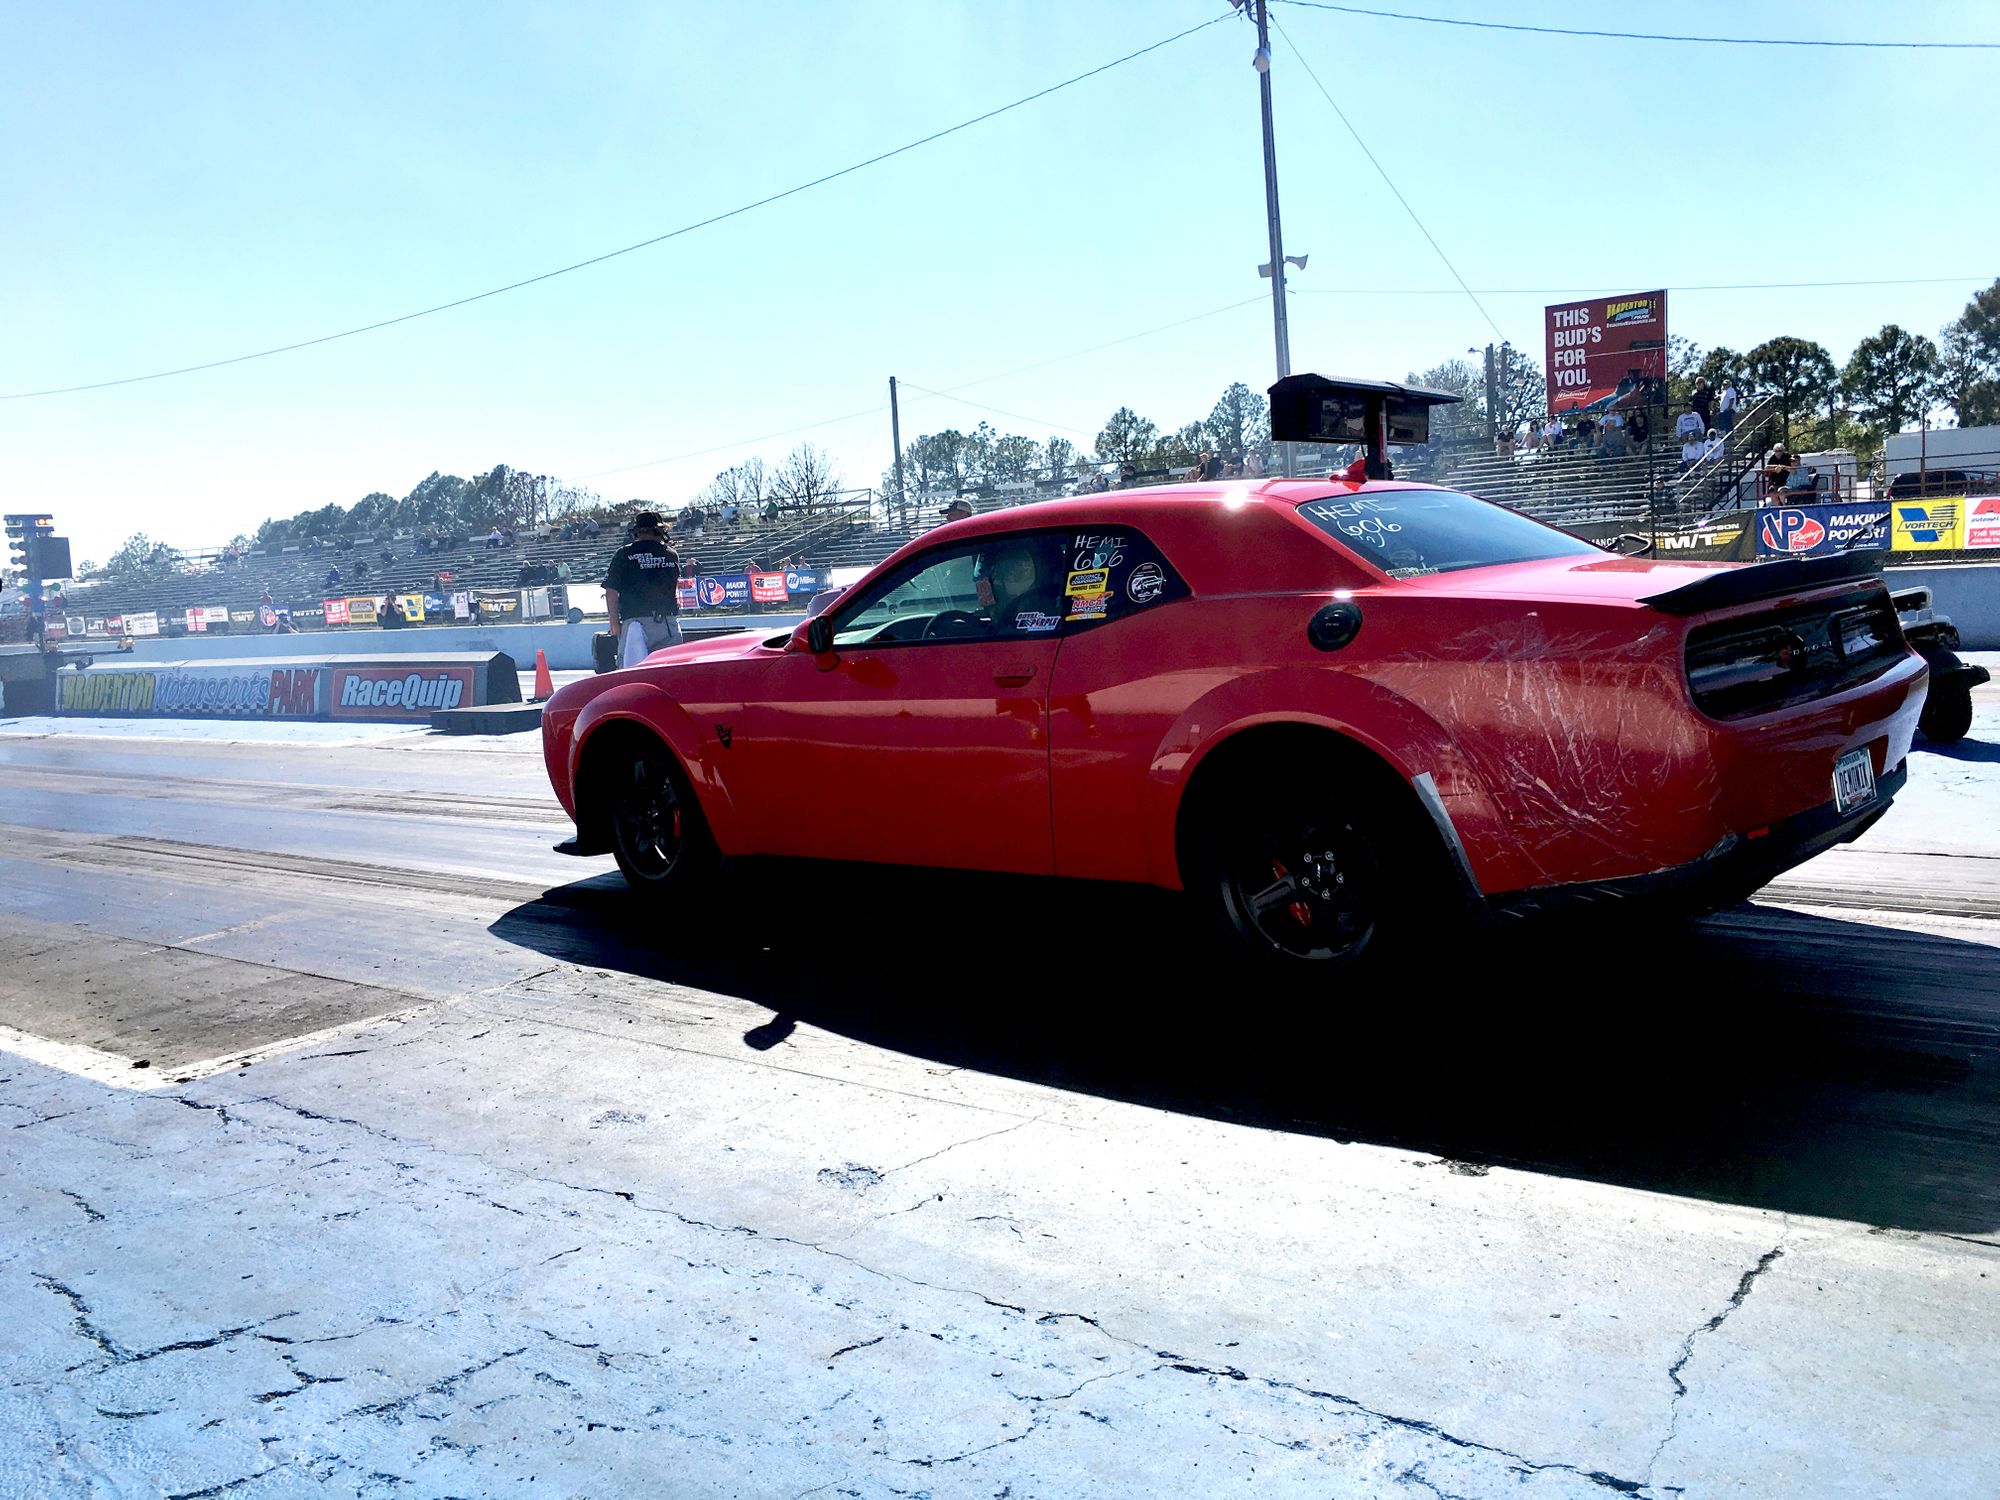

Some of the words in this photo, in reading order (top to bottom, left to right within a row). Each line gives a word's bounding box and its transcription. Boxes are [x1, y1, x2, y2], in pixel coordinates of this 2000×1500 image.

[1553, 308, 1590, 328] THIS
[1606, 300, 1648, 319] BRADENTON
[1554, 327, 1602, 348] BUD'S
[1554, 348, 1586, 368] FOR
[1554, 368, 1592, 387] YOU.
[1307, 500, 1398, 521] HEMI
[1676, 523, 1740, 537] THOMPSON
[1763, 509, 1806, 551] VP
[1905, 521, 1953, 530] VORTECH
[1075, 535, 1128, 549] HEMI
[1664, 533, 1717, 550] M/T
[1791, 529, 1824, 546] Racing
[1074, 550, 1124, 571] 606
[800, 576, 816, 584] Miller
[292, 608, 324, 617] NITTO
[488, 603, 508, 612] M/T
[1073, 599, 1103, 608] NMCA
[64, 673, 156, 712] BRADENTON
[154, 672, 270, 708] Motorsports
[268, 669, 319, 715] PARK
[340, 673, 464, 710] RaceQuip
